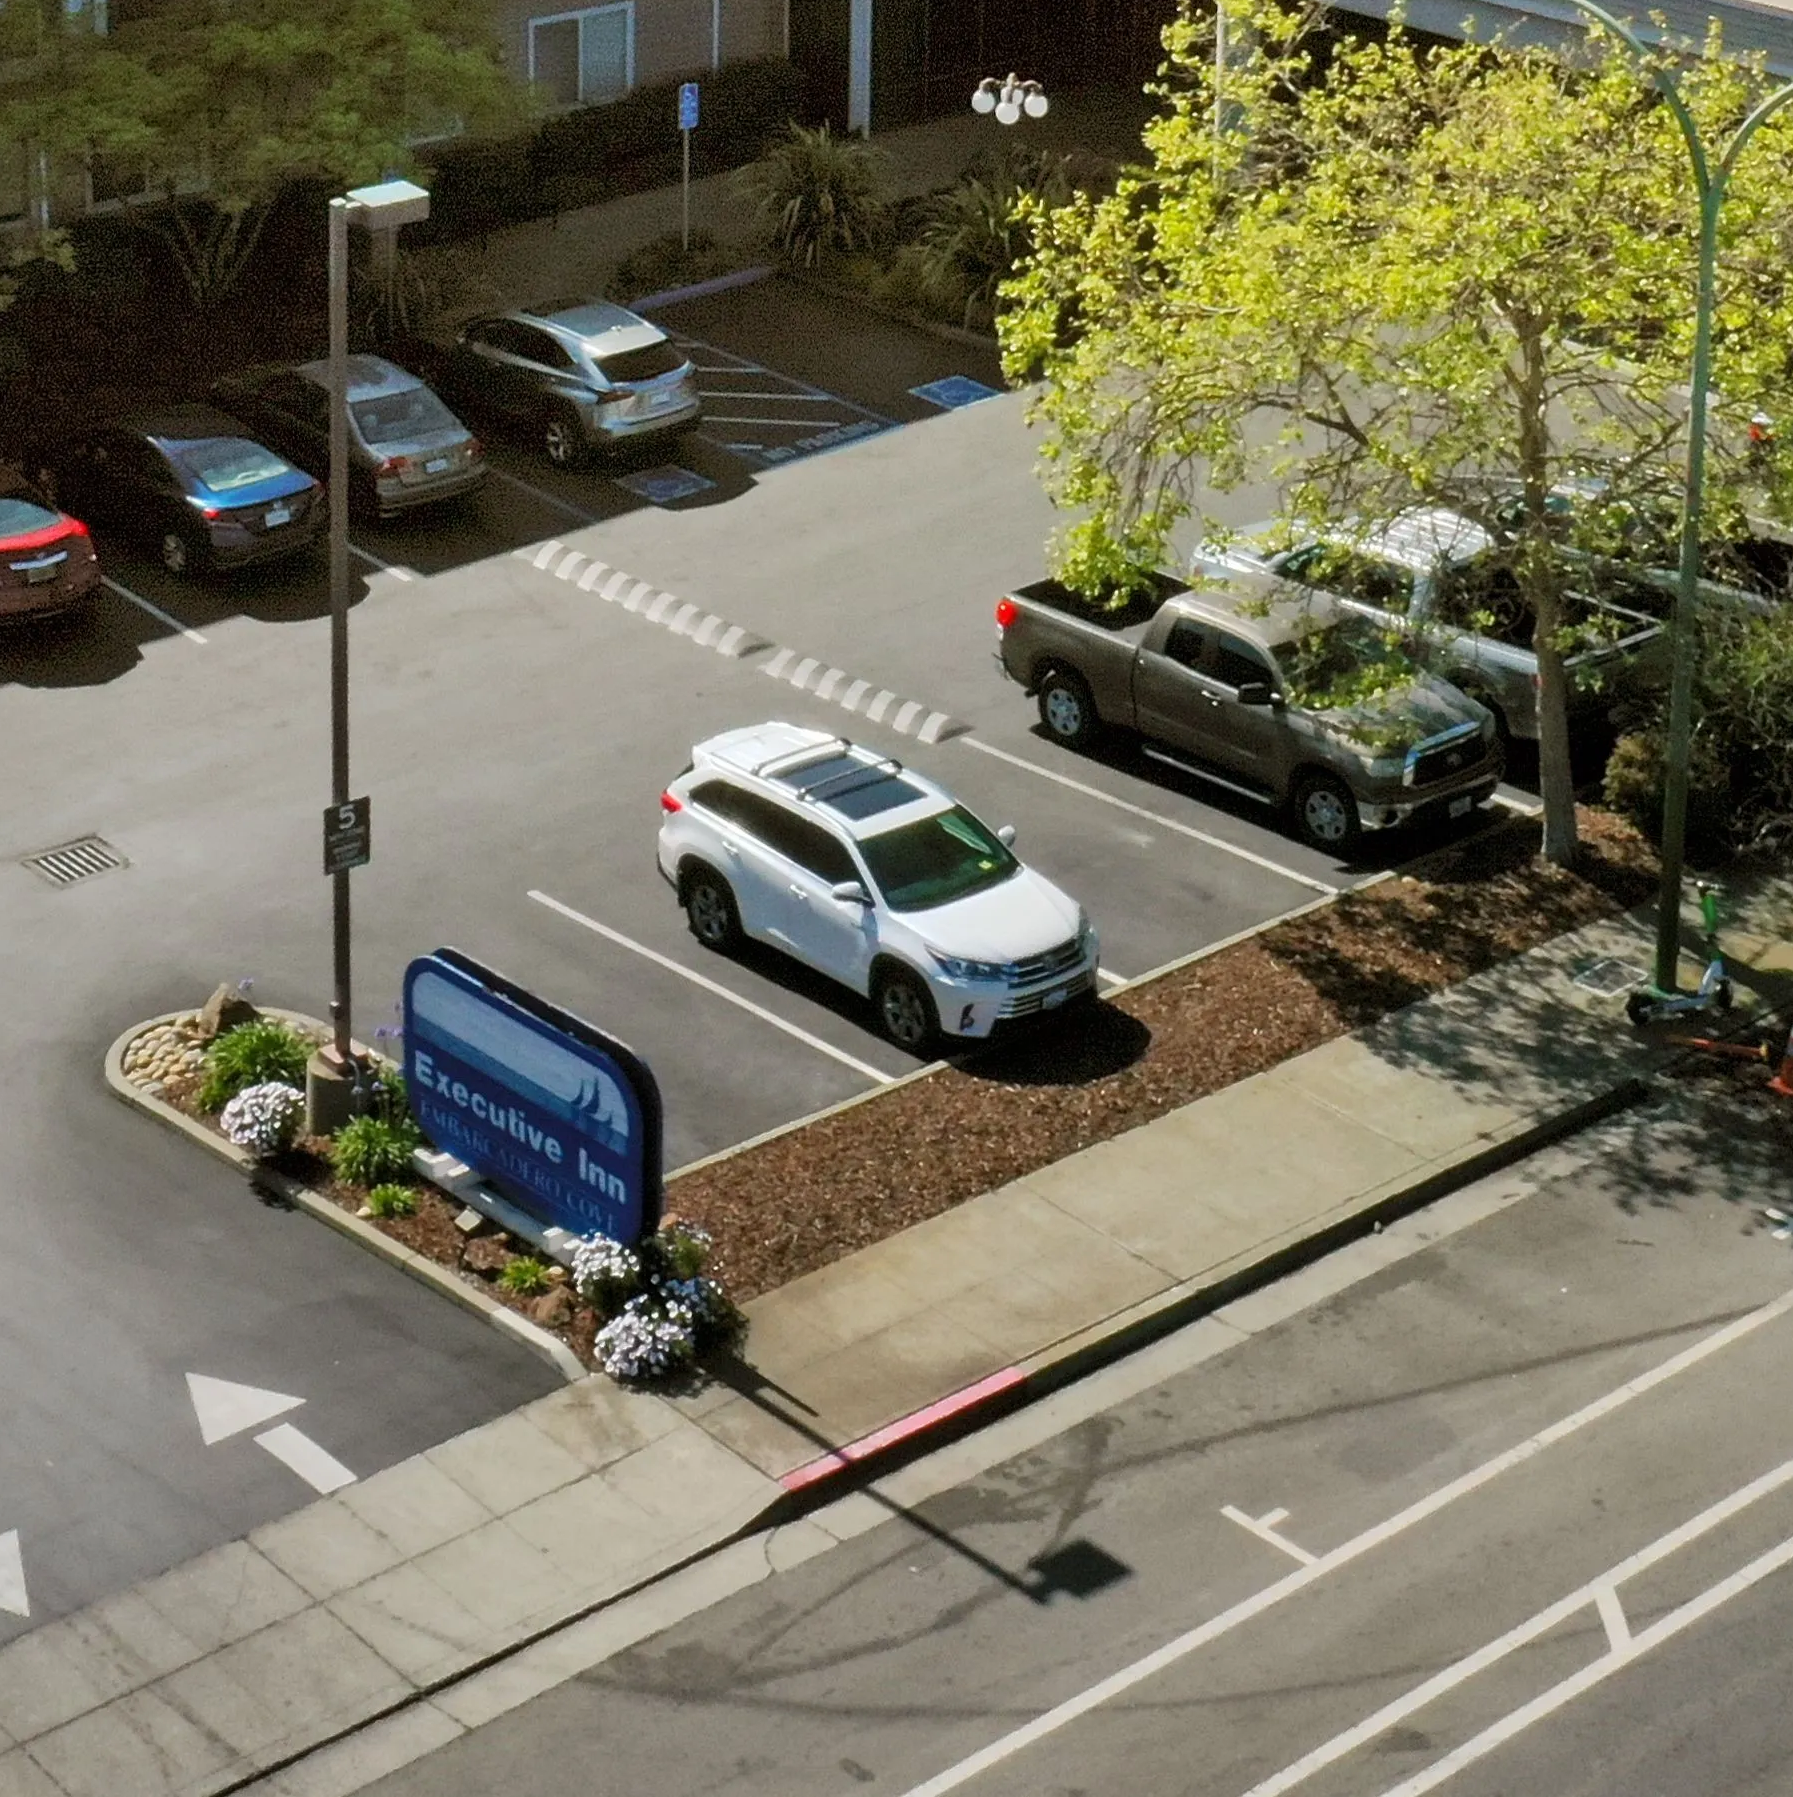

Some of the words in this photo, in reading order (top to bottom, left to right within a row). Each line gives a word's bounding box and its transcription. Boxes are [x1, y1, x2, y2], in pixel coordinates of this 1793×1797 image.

[339, 804, 356, 830] 5
[414, 1050, 564, 1164] Executive
[578, 1147, 626, 1204] Inn
[419, 1100, 561, 1199] EMBARCADERO
[566, 1191, 620, 1234] COVE
